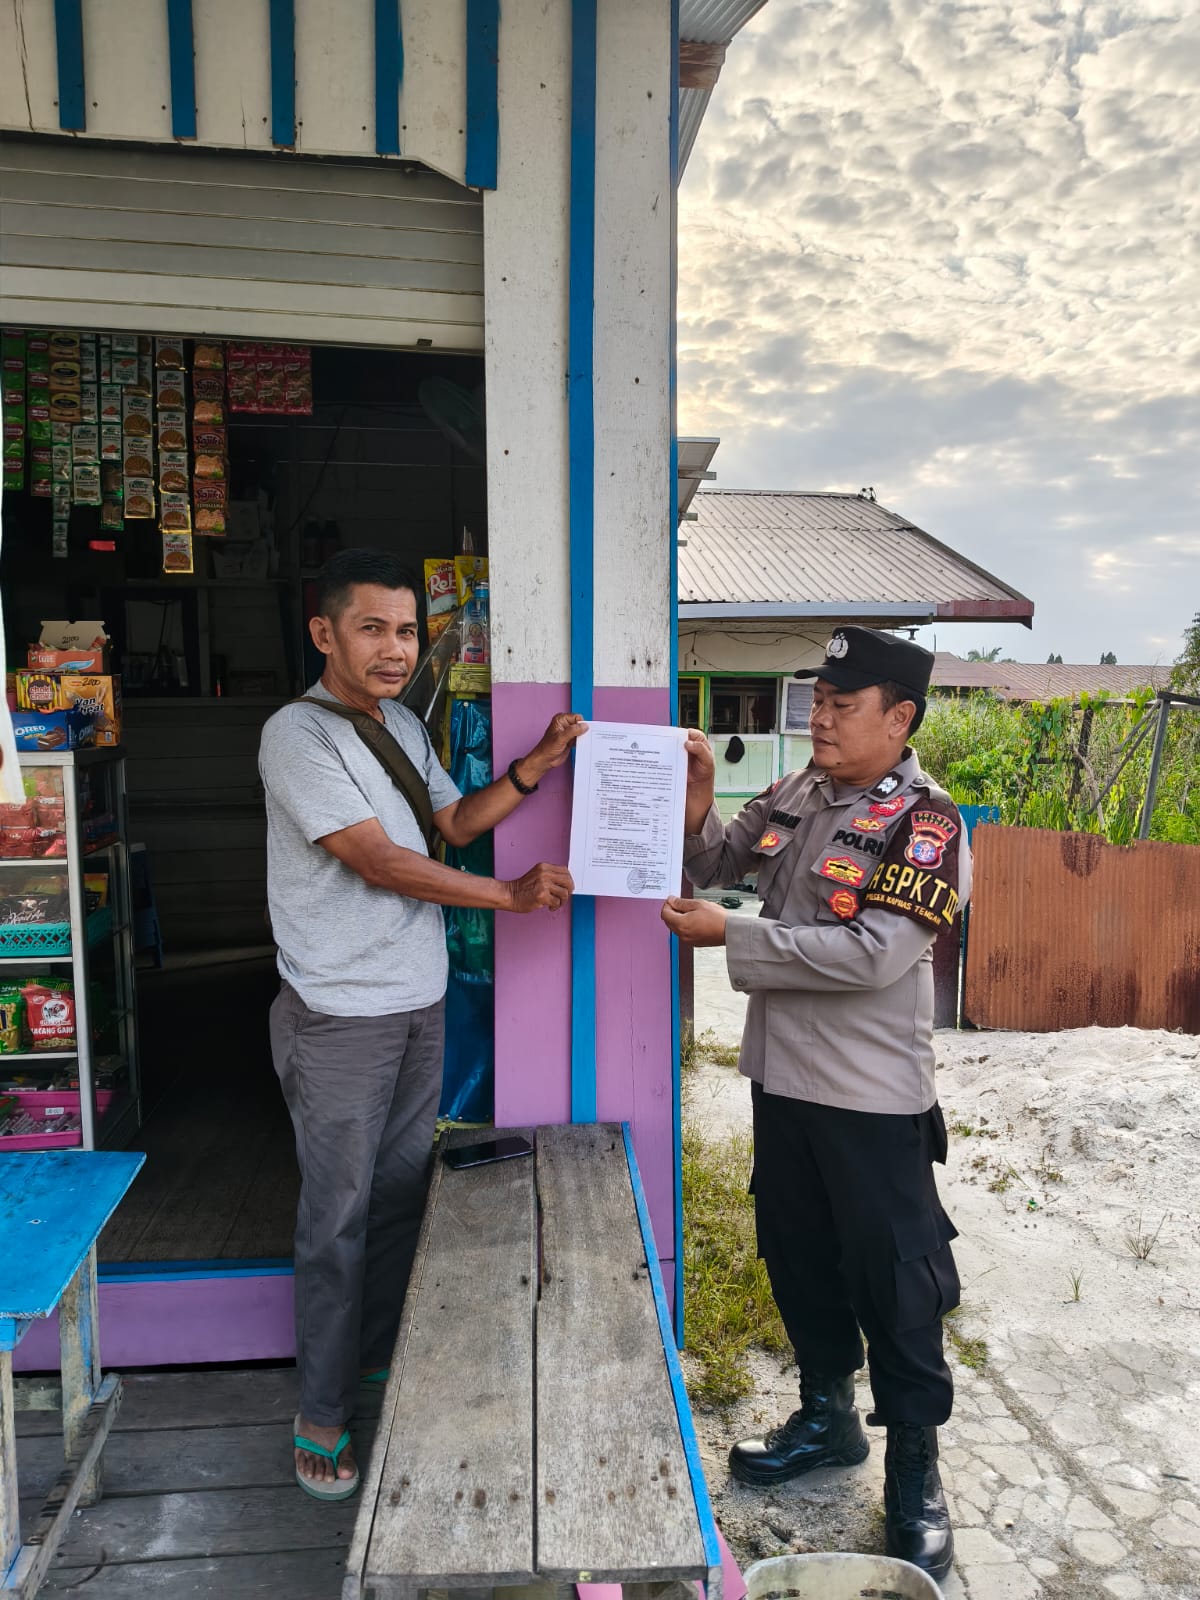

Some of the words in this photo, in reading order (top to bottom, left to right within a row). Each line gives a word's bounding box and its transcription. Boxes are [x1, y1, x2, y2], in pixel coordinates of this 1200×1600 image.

[15, 725, 46, 737] OREO
[832, 829, 885, 856] POLRI
[881, 863, 949, 909] SPKT
[941, 887, 960, 926] III
[914, 904, 942, 926] TENGAH
